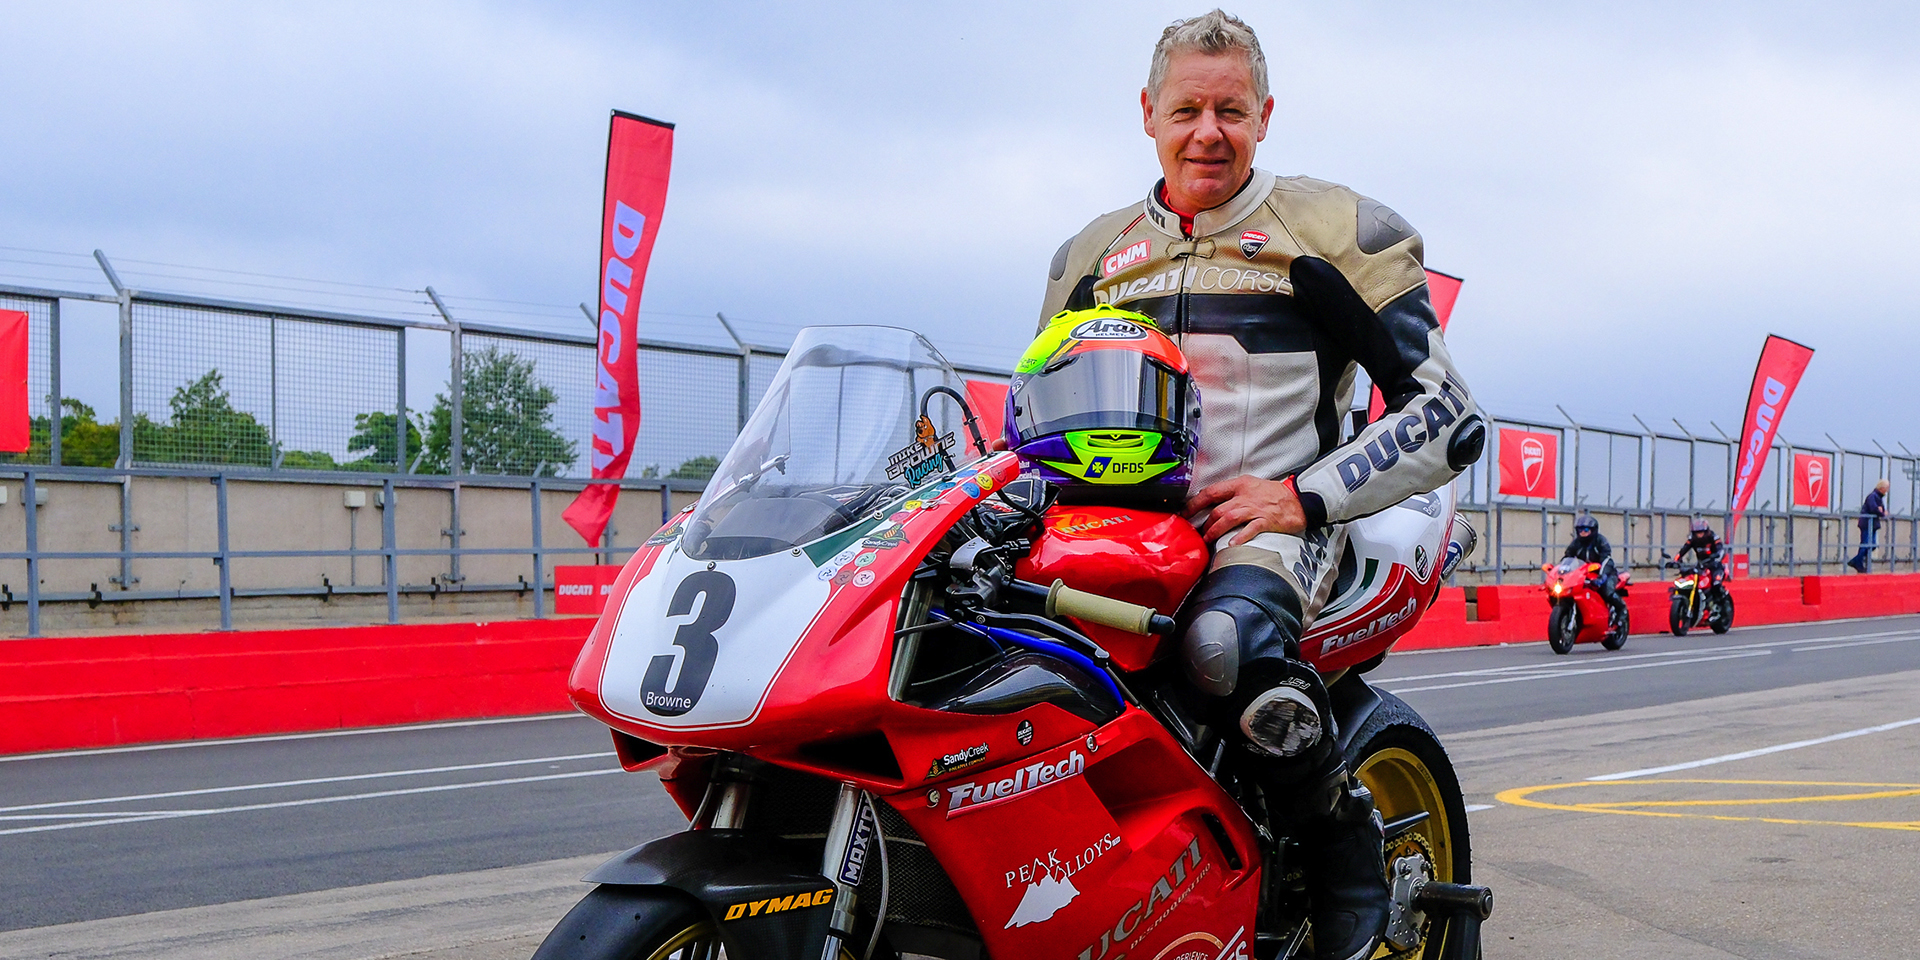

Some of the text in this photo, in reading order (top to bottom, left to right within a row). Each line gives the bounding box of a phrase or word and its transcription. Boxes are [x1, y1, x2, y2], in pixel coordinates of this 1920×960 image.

[1244, 232, 1266, 241] DUCATI
[1106, 242, 1148, 273] CWM
[1094, 266, 1294, 306] DUCATI CORSE
[1077, 320, 1139, 336] Arai
[1336, 370, 1469, 494] DUCATI
[889, 441, 923, 467] MIKE
[904, 452, 943, 489] Racing
[1112, 463, 1144, 474] DFDS
[1061, 515, 1133, 533] DUCATI
[559, 585, 593, 595] DUCATI
[1321, 597, 1417, 655] FuelTech
[640, 570, 736, 716] 3
[646, 690, 692, 709] Browne
[943, 742, 990, 766] SandyCreek
[947, 750, 1085, 809] FuelTech
[724, 888, 834, 921] DYMAG
